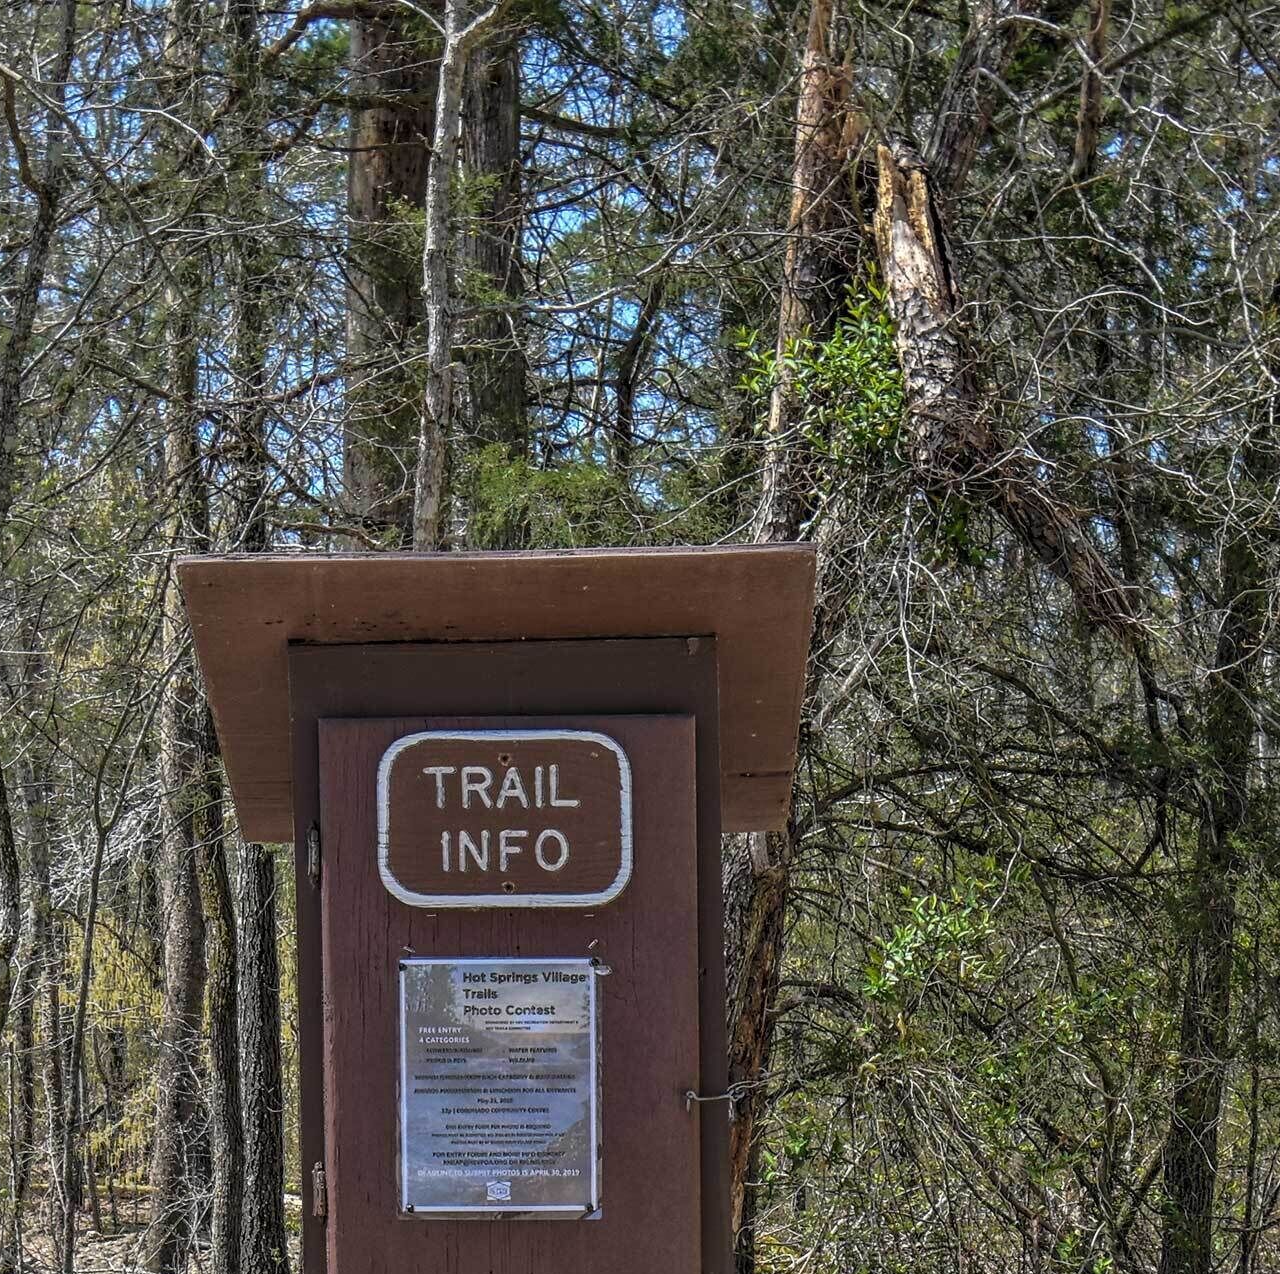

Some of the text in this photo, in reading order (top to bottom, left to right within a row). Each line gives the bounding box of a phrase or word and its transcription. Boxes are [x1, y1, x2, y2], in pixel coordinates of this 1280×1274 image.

[422, 764, 582, 809] TRAIL
[440, 829, 570, 872] INFO
[463, 972, 586, 985] Hot Springs Village
[463, 989, 498, 999] Trails
[463, 1005, 555, 1016] Photo Contest
